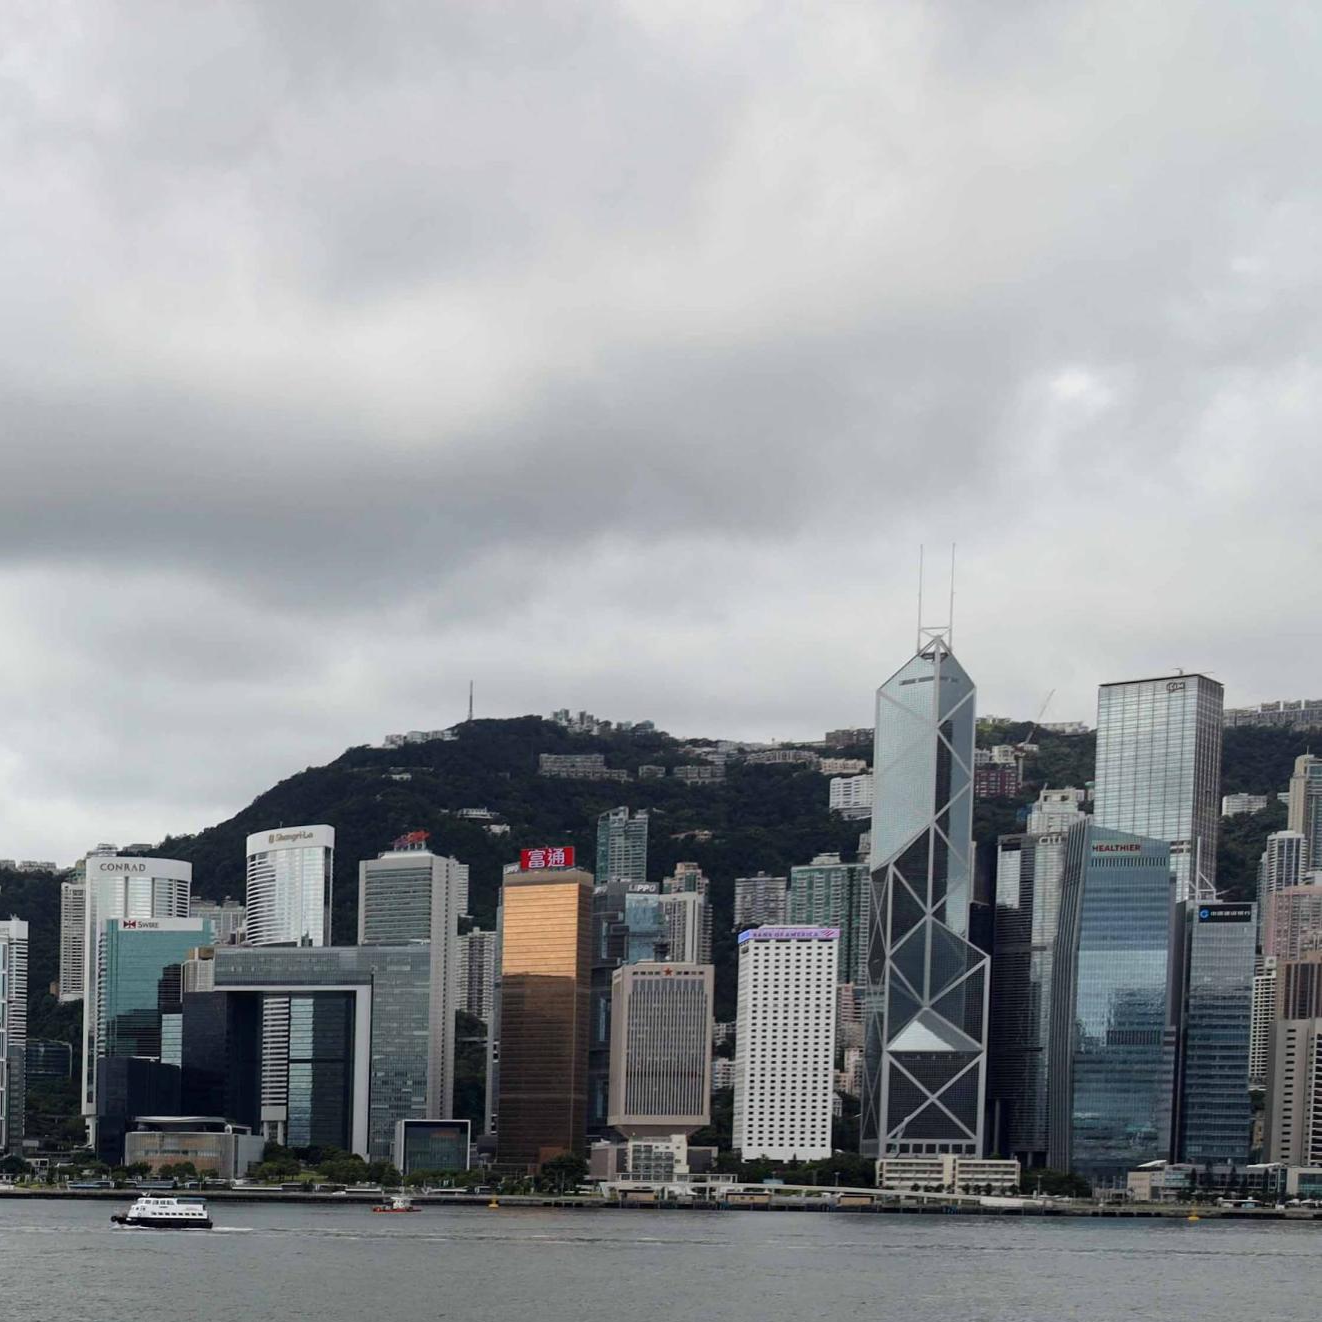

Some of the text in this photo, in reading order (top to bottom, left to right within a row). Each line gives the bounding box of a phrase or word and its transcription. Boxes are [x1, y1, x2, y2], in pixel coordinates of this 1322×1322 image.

[1092, 844, 1141, 852] HEALTHIER
[528, 848, 566, 868] 富通
[100, 863, 146, 871] CONRAD
[628, 883, 657, 892] LIPPO
